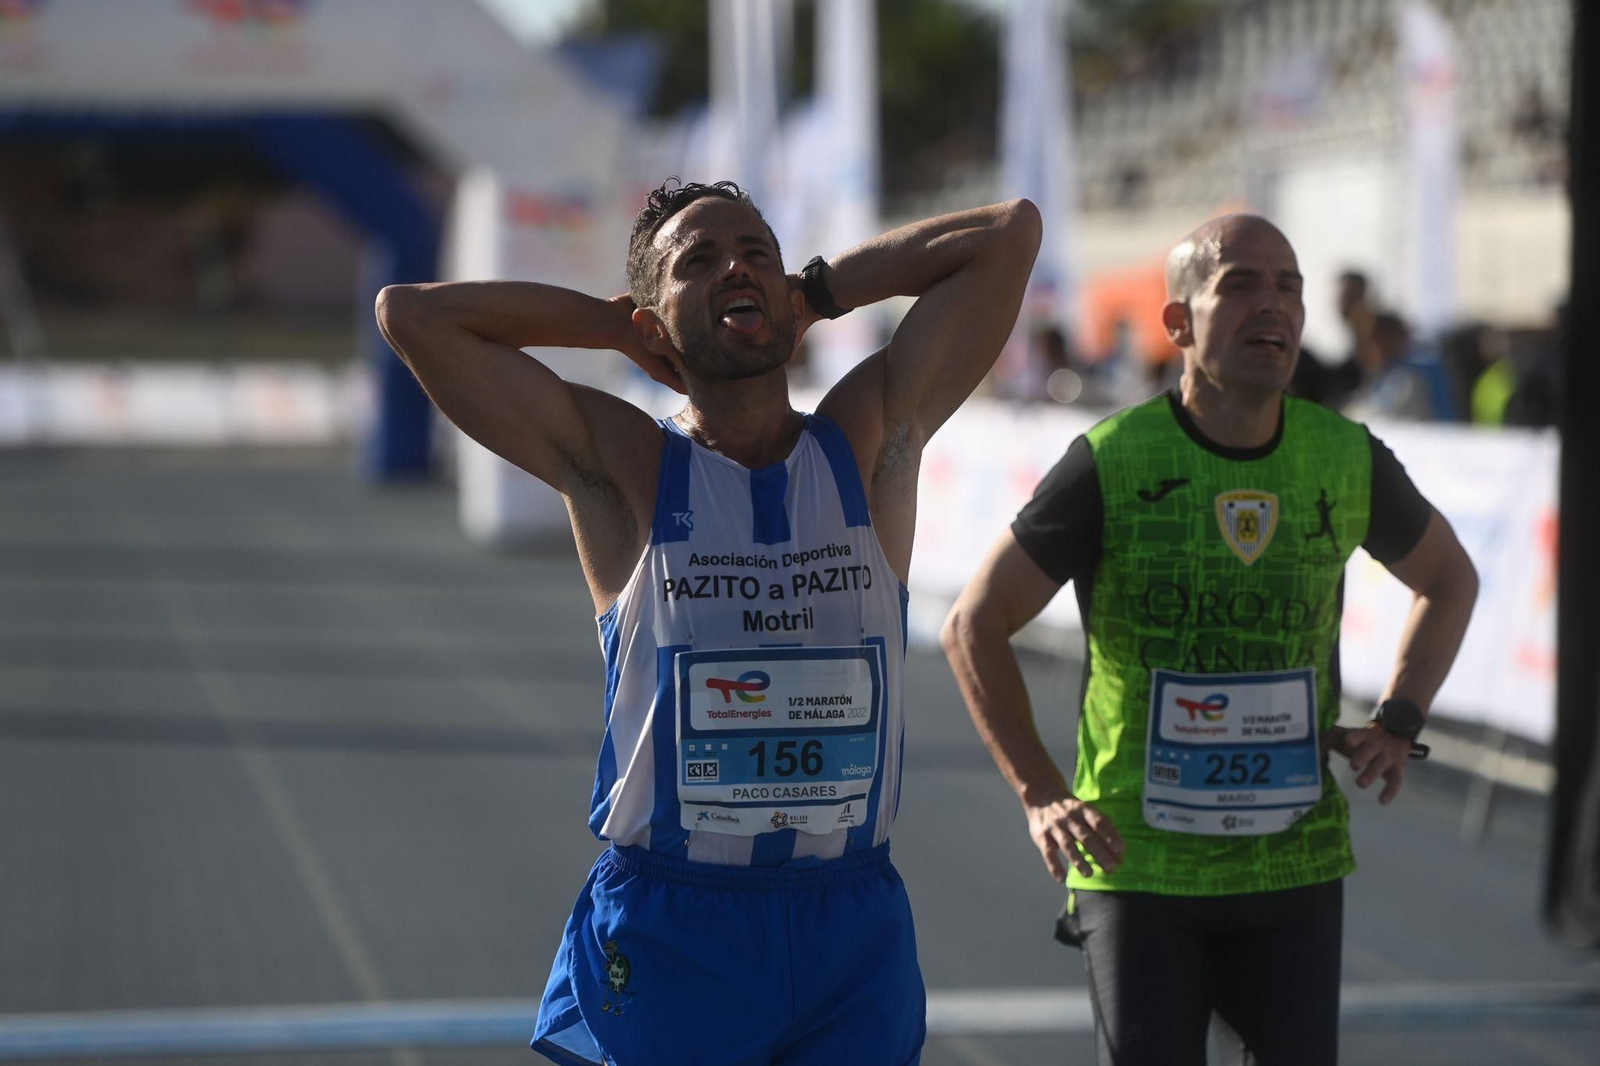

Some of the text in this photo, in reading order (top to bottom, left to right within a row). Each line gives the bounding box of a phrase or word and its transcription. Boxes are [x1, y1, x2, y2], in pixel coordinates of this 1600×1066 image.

[688, 543, 852, 570] Asociación Deportiva
[663, 565, 872, 601] PAZITO a PAZITO
[743, 607, 814, 632] Motril
[788, 694, 853, 707] 1/2 MARATÓN
[707, 708, 772, 720] TotalEnergies
[788, 707, 867, 720] DE MÁLAGA 2022
[749, 740, 824, 777] 156
[1204, 753, 1272, 785] 252
[733, 786, 837, 799] PACO CASARES
[1216, 793, 1257, 803] MARIO
